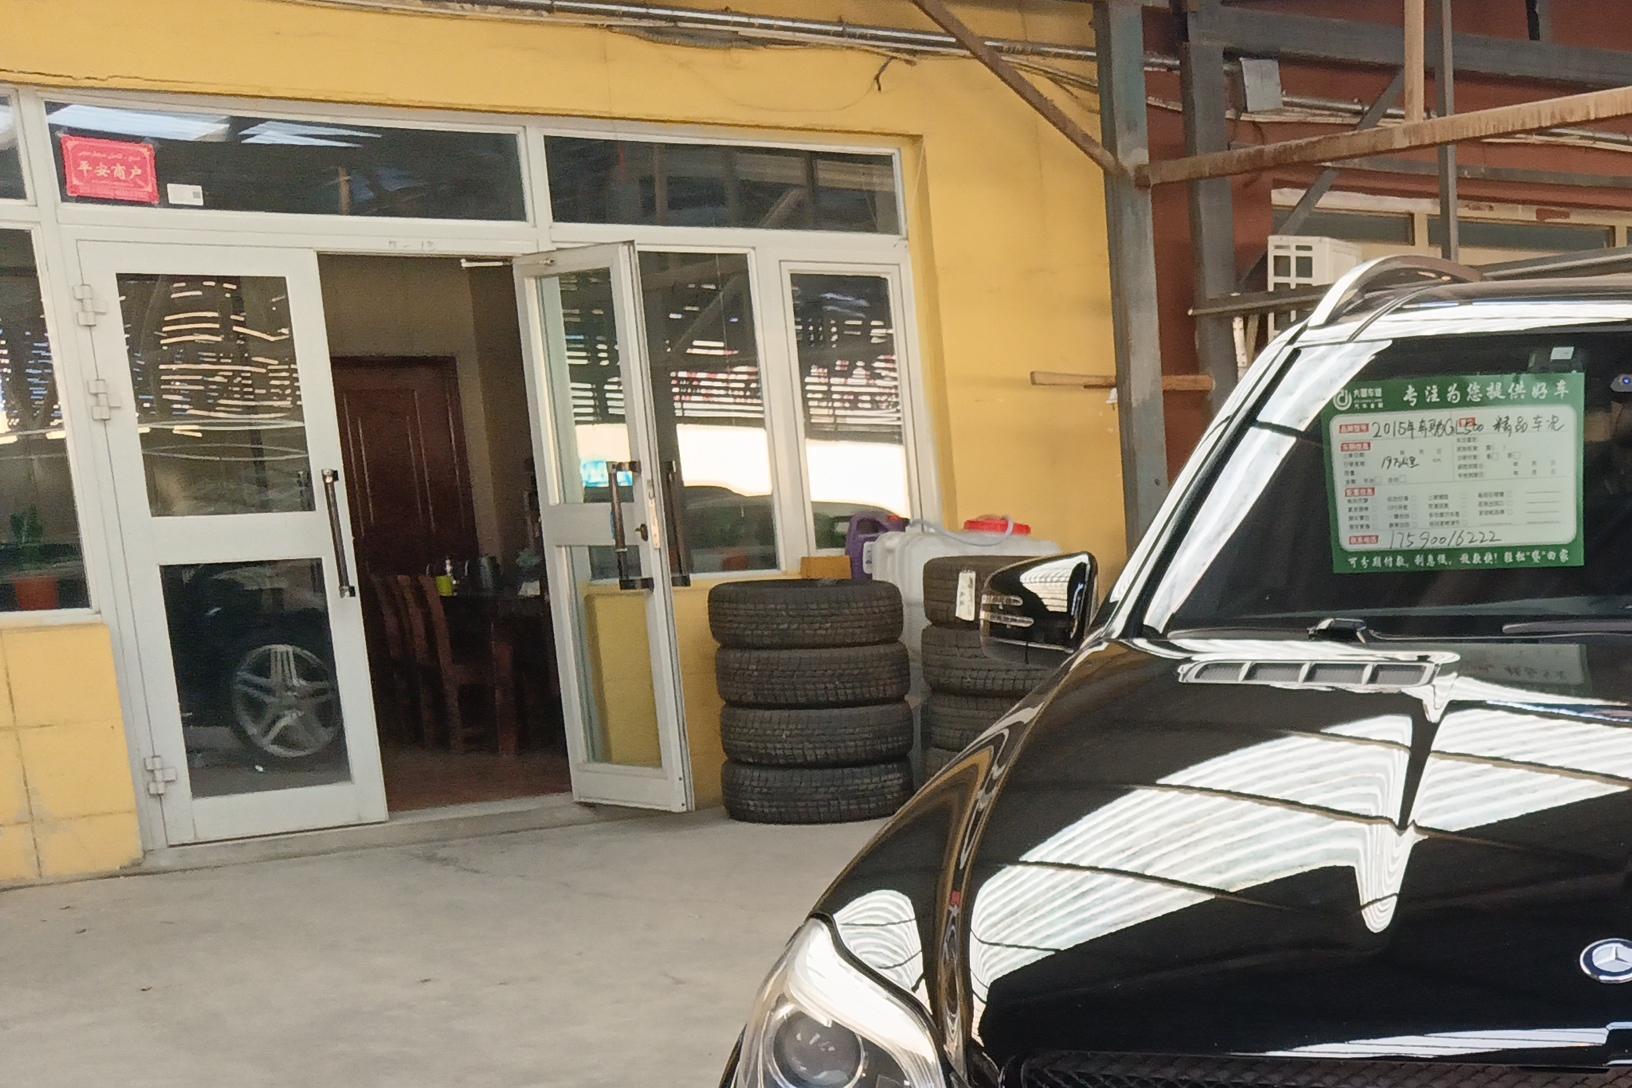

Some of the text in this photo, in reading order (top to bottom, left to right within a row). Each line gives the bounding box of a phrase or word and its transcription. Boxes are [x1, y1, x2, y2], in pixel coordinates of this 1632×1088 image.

[77, 160, 142, 180] 平安商户
[1403, 380, 1569, 406] 专注为您提供好车
